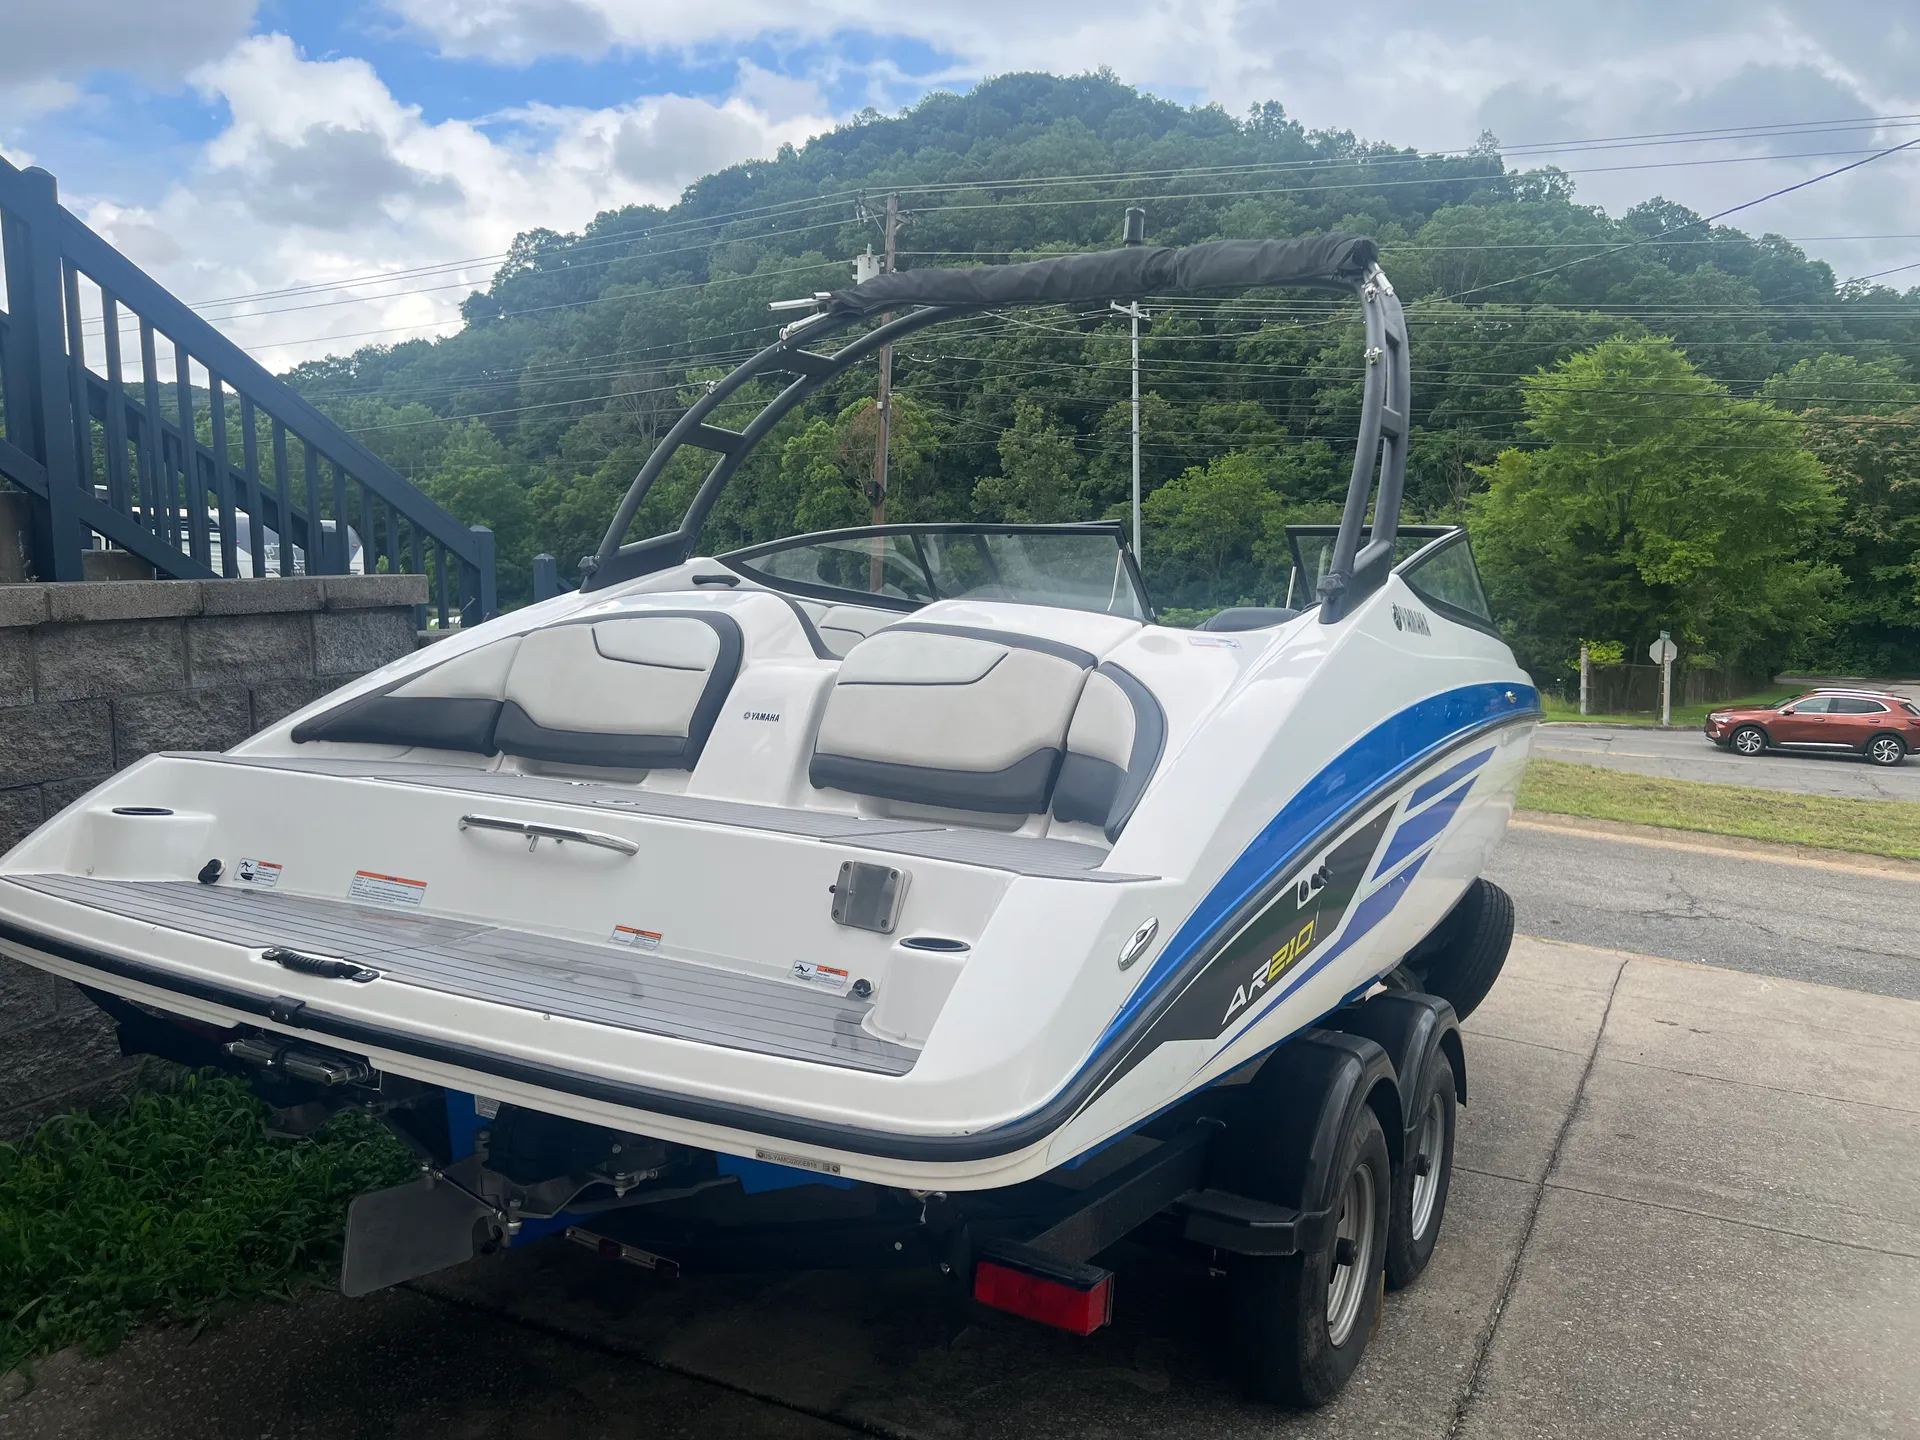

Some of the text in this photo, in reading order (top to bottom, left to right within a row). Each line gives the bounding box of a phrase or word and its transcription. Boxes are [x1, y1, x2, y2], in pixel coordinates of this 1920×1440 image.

[1397, 605, 1431, 637] YAMAHA
[751, 712, 780, 722] YAMAHA
[1221, 919, 1315, 1025] AR210
